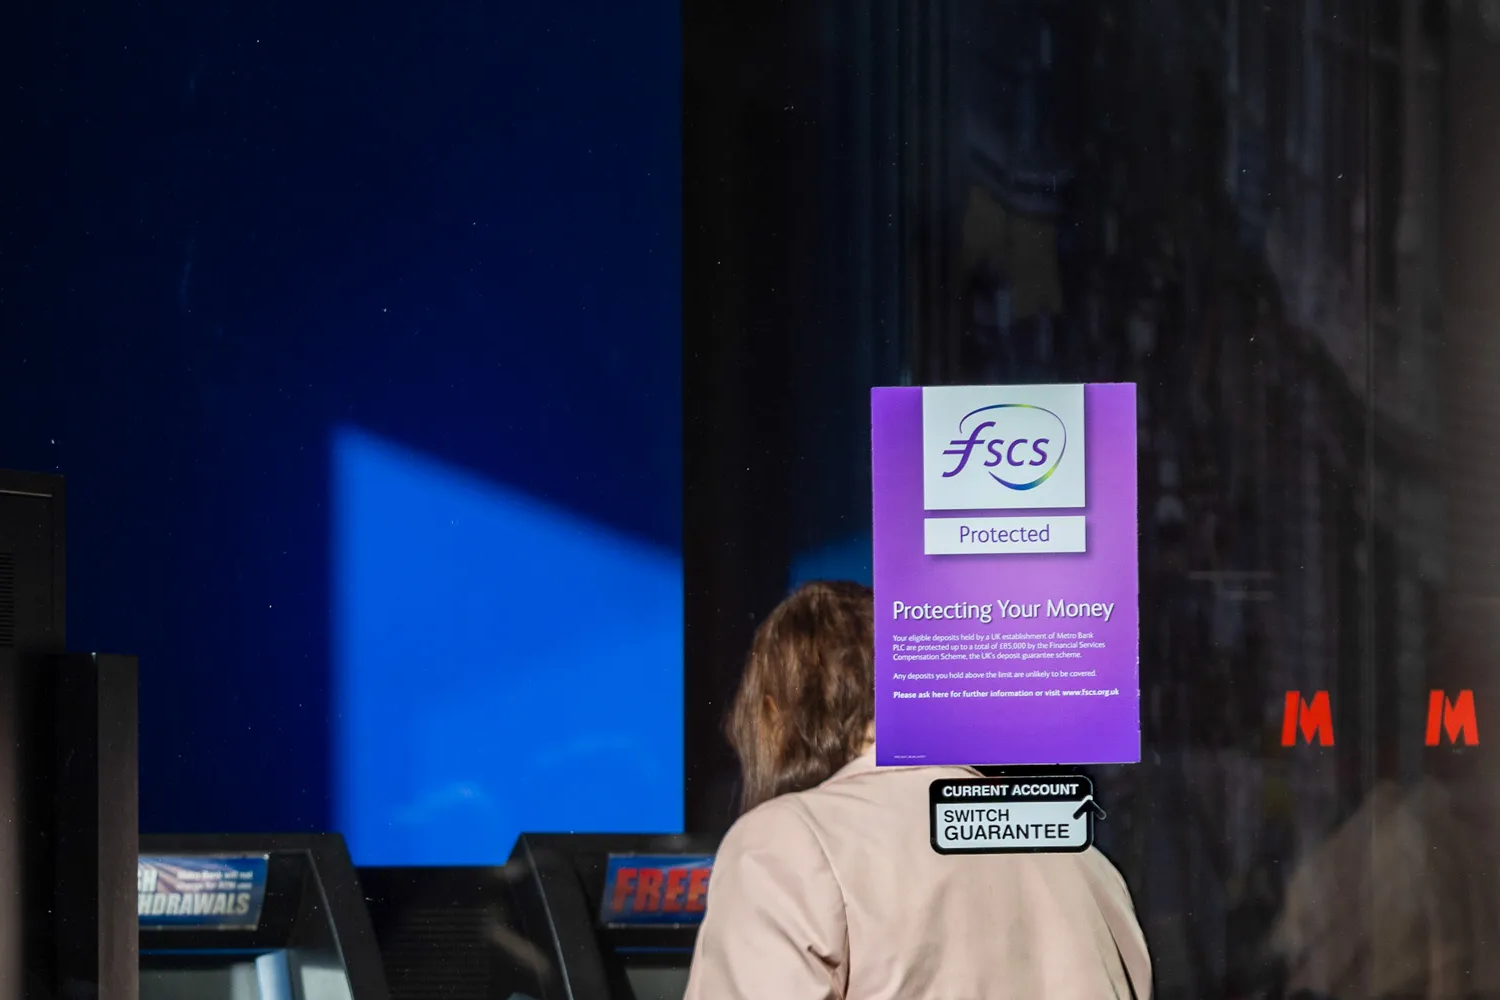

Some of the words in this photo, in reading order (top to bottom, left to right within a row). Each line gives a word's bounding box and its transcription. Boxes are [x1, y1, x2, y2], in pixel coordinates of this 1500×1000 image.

[959, 524, 1050, 543] Protected
[892, 600, 993, 623] Protecting
[997, 599, 1040, 620] Your
[1046, 598, 1115, 623] Money
[893, 634, 907, 642] Your
[908, 634, 931, 643] eligible
[932, 634, 959, 642] deposits
[960, 633, 975, 641] held
[976, 633, 984, 642] by
[1002, 632, 1047, 640] establishment
[1048, 632, 1056, 640] of
[1057, 632, 1077, 640] Metro
[1078, 631, 1094, 639] Bank
[917, 643, 949, 652] protected
[974, 643, 990, 651] total
[1027, 641, 1037, 651] by
[1037, 641, 1048, 650] the
[1049, 641, 1079, 650] Financial
[1079, 641, 1106, 649] Services
[893, 653, 940, 662] Compensation
[969, 652, 980, 660] the
[996, 651, 1021, 660] deposit
[1021, 652, 1055, 661] guarantee
[1055, 651, 1083, 659] scheme.
[893, 672, 907, 681] Any
[907, 672, 935, 681] deposits
[935, 673, 948, 681] you
[949, 671, 964, 679] hold
[964, 671, 985, 679] above
[985, 671, 997, 679] the
[998, 670, 1013, 678] limit
[1025, 670, 1051, 679] unlikely
[1060, 670, 1069, 678] be
[1069, 669, 1097, 678] covered.
[893, 690, 917, 699] Please
[918, 690, 930, 698] ask
[932, 690, 949, 698] here
[950, 689, 961, 698] for
[962, 689, 989, 698] further
[990, 688, 1033, 698] information
[1044, 688, 1061, 697] visit
[1062, 687, 1120, 697] www.fscs.org.uk
[1280, 689, 1335, 747] M
[1425, 689, 1480, 747] M
[942, 784, 1009, 799] CURRENT
[1011, 783, 1079, 797] ACCOUNT
[943, 807, 1010, 823] SWITCH
[944, 822, 1071, 842] GUARANTEE
[612, 867, 711, 913] FREE
